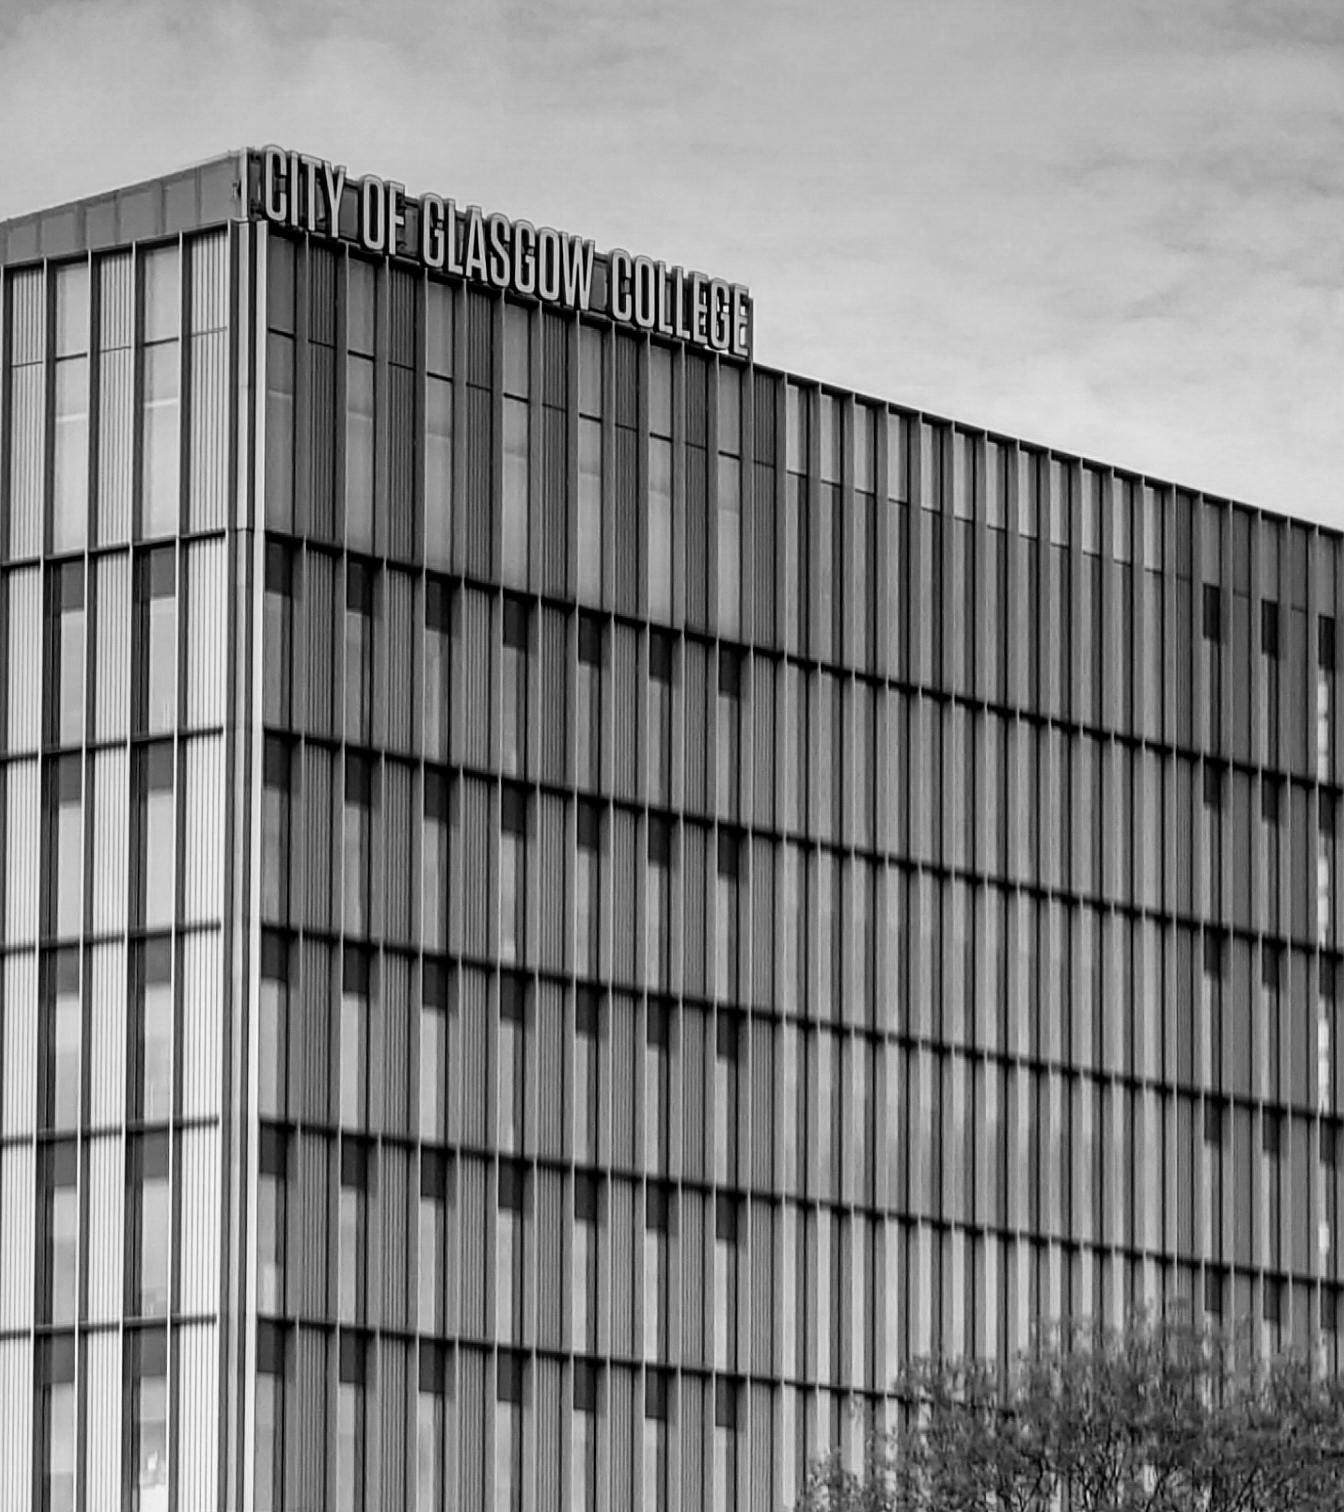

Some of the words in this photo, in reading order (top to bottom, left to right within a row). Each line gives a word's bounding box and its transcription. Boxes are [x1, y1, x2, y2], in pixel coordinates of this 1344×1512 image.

[264, 145, 346, 238] CITY
[361, 175, 405, 255] OF
[421, 193, 595, 311] GLASGOW
[611, 249, 750, 357] COLLEGE
